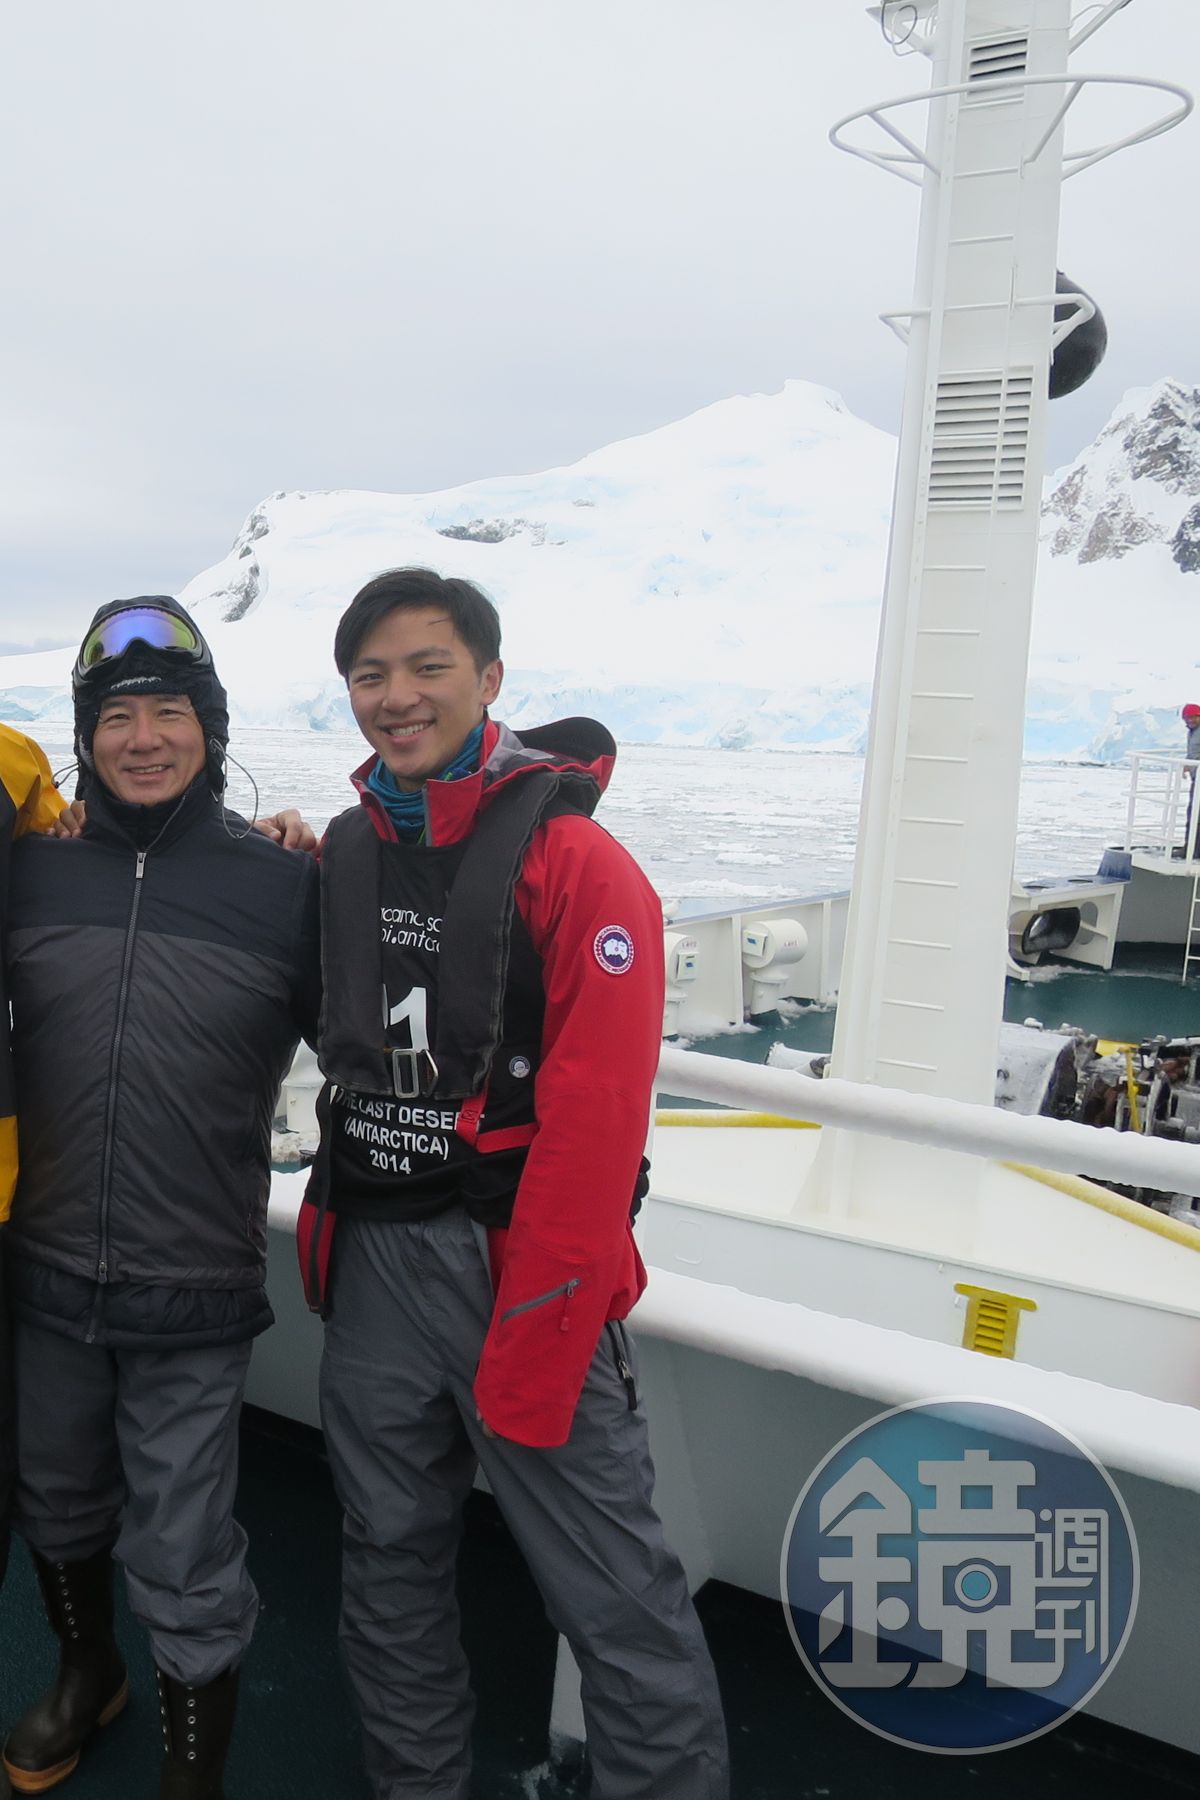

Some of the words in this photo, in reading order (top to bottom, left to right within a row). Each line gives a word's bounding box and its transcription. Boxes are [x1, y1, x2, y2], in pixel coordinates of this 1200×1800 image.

[398, 1106, 485, 1131] DESE
[344, 1116, 450, 1161] (ANTARCTICA)
[369, 1149, 412, 1175] 2014
